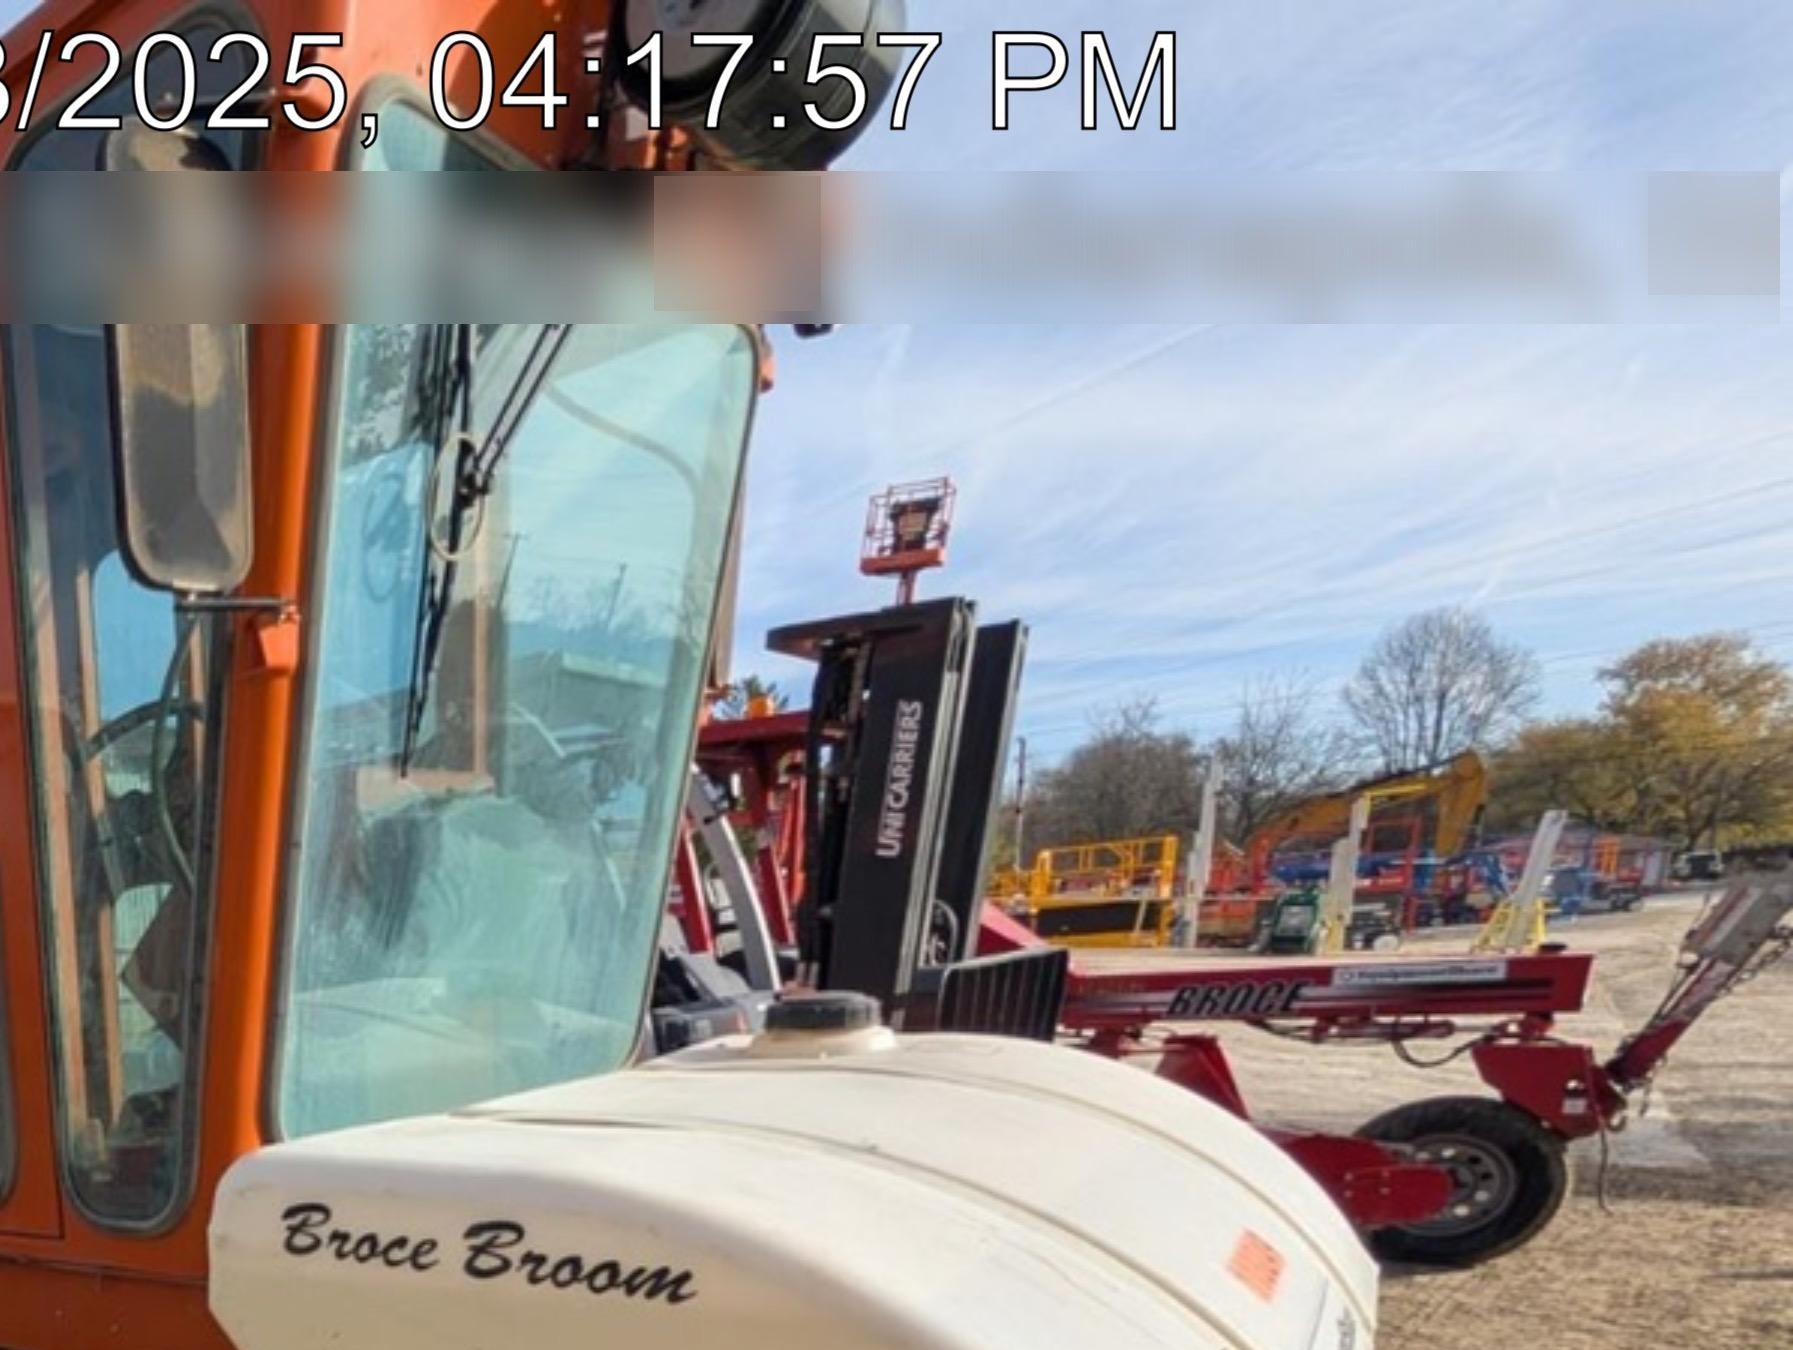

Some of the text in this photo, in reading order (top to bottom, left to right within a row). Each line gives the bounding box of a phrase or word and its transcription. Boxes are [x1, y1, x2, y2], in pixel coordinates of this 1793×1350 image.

[874, 699, 923, 859] UNICARRIERS
[1165, 980, 1310, 1018] BROCE
[281, 1201, 698, 1306] Broce Broom
